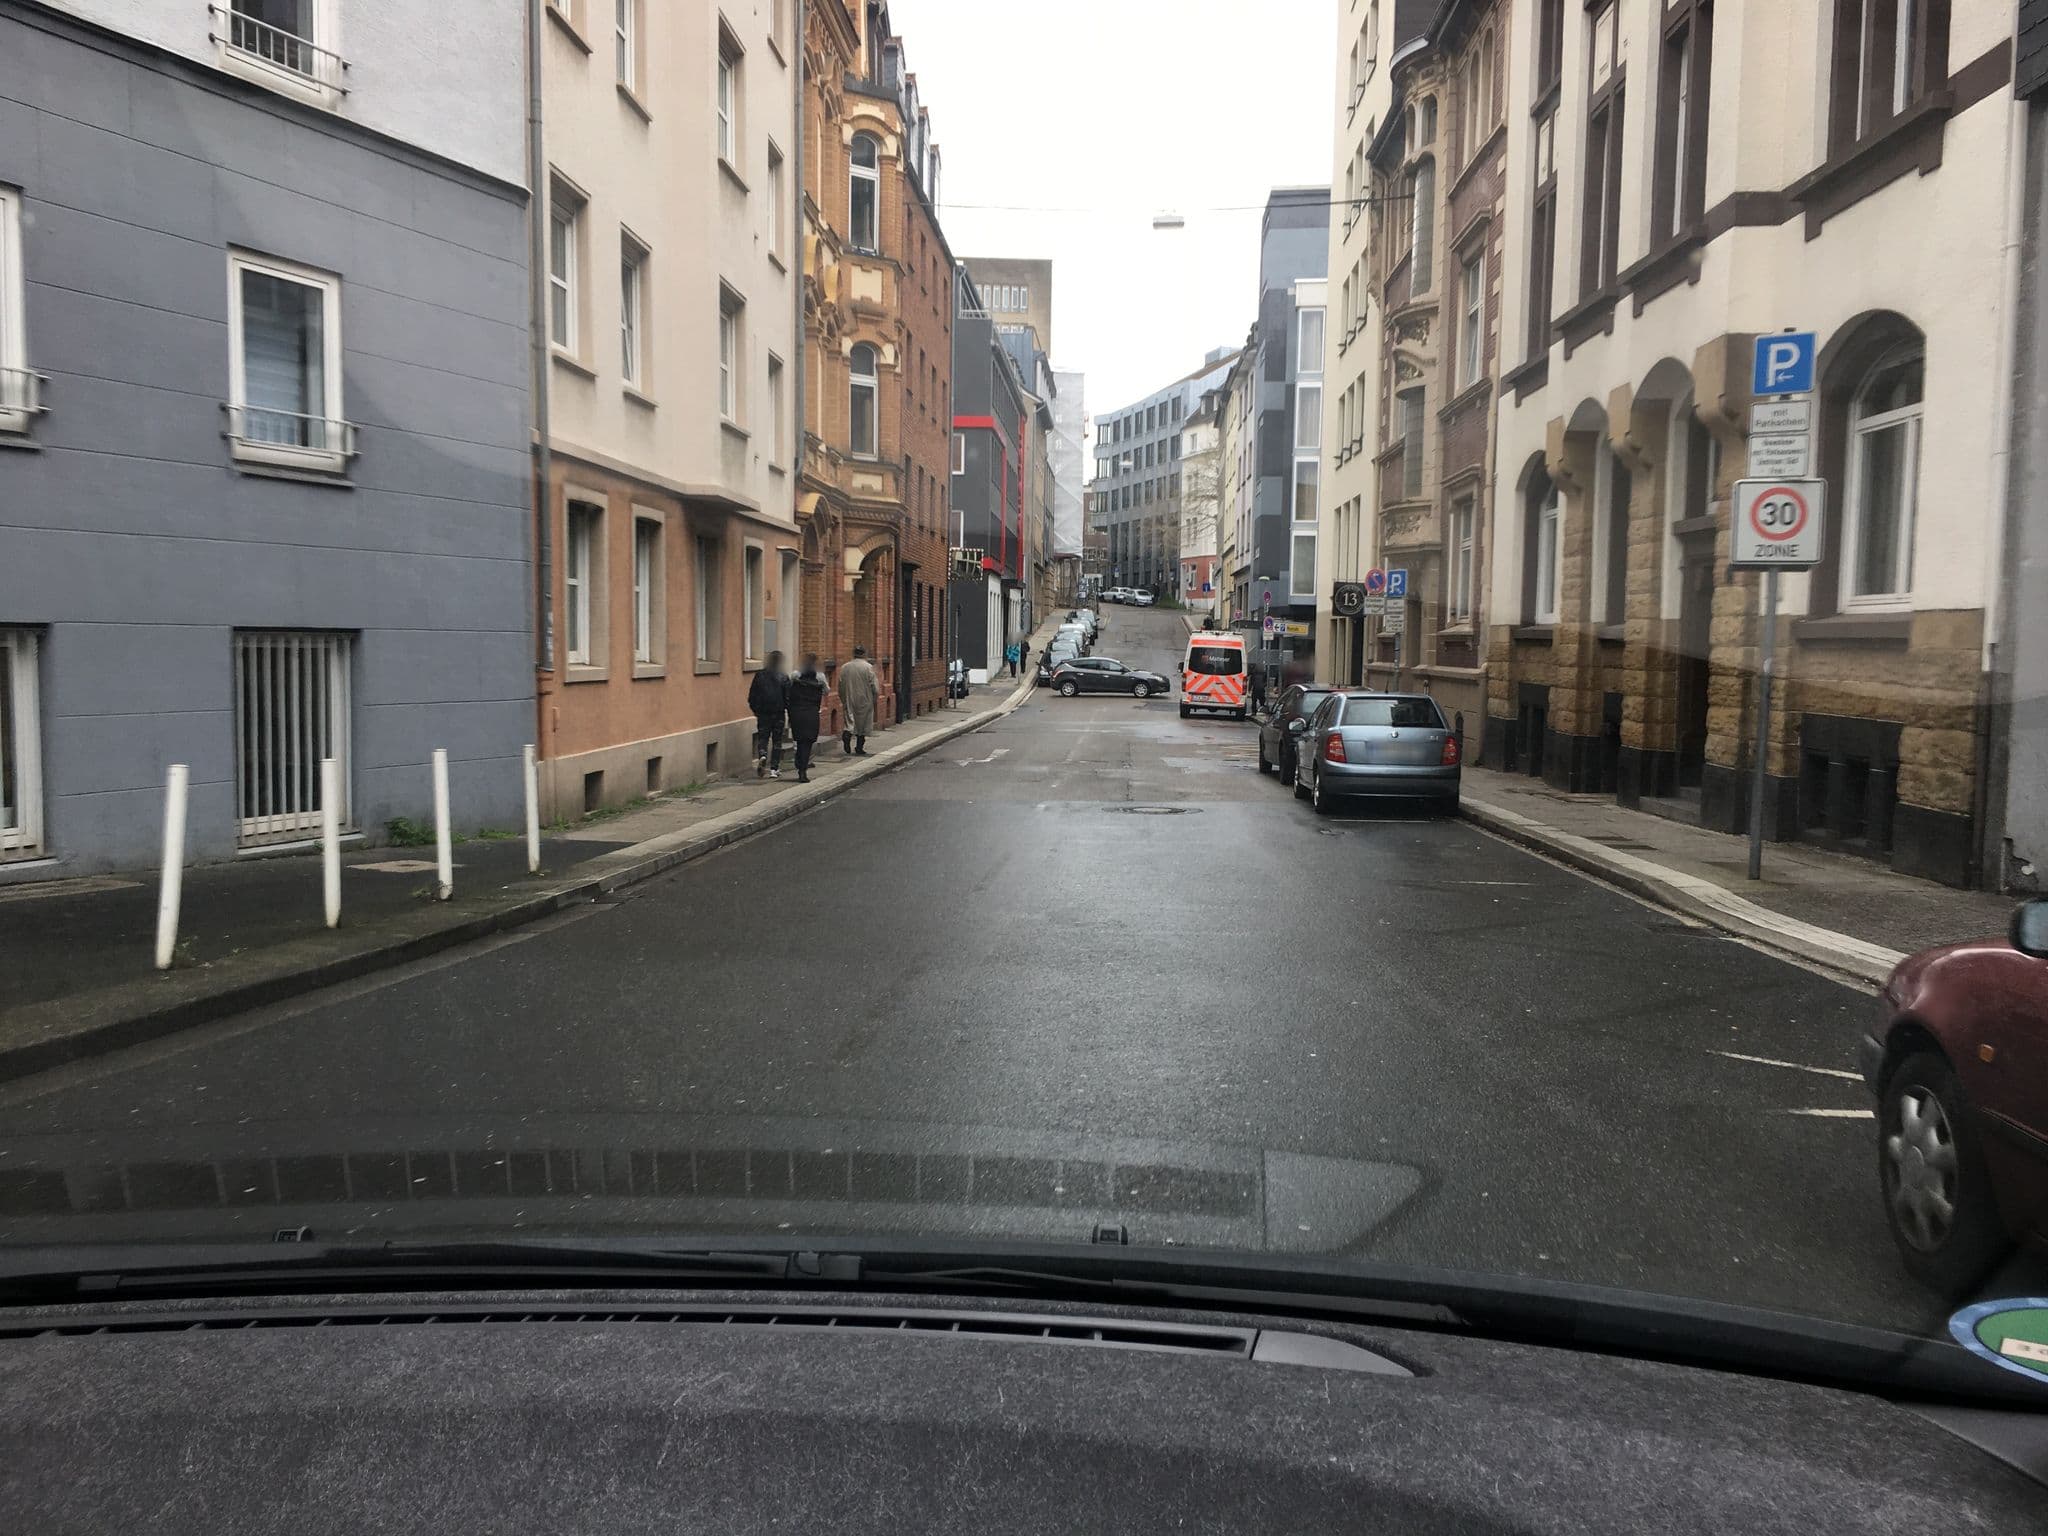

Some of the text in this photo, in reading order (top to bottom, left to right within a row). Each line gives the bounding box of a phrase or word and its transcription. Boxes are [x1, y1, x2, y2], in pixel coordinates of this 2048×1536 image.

[1766, 343, 1801, 387] P
[1762, 502, 1796, 526] 30
[1754, 543, 1801, 558] ZONE
[1343, 592, 1357, 606] 13
